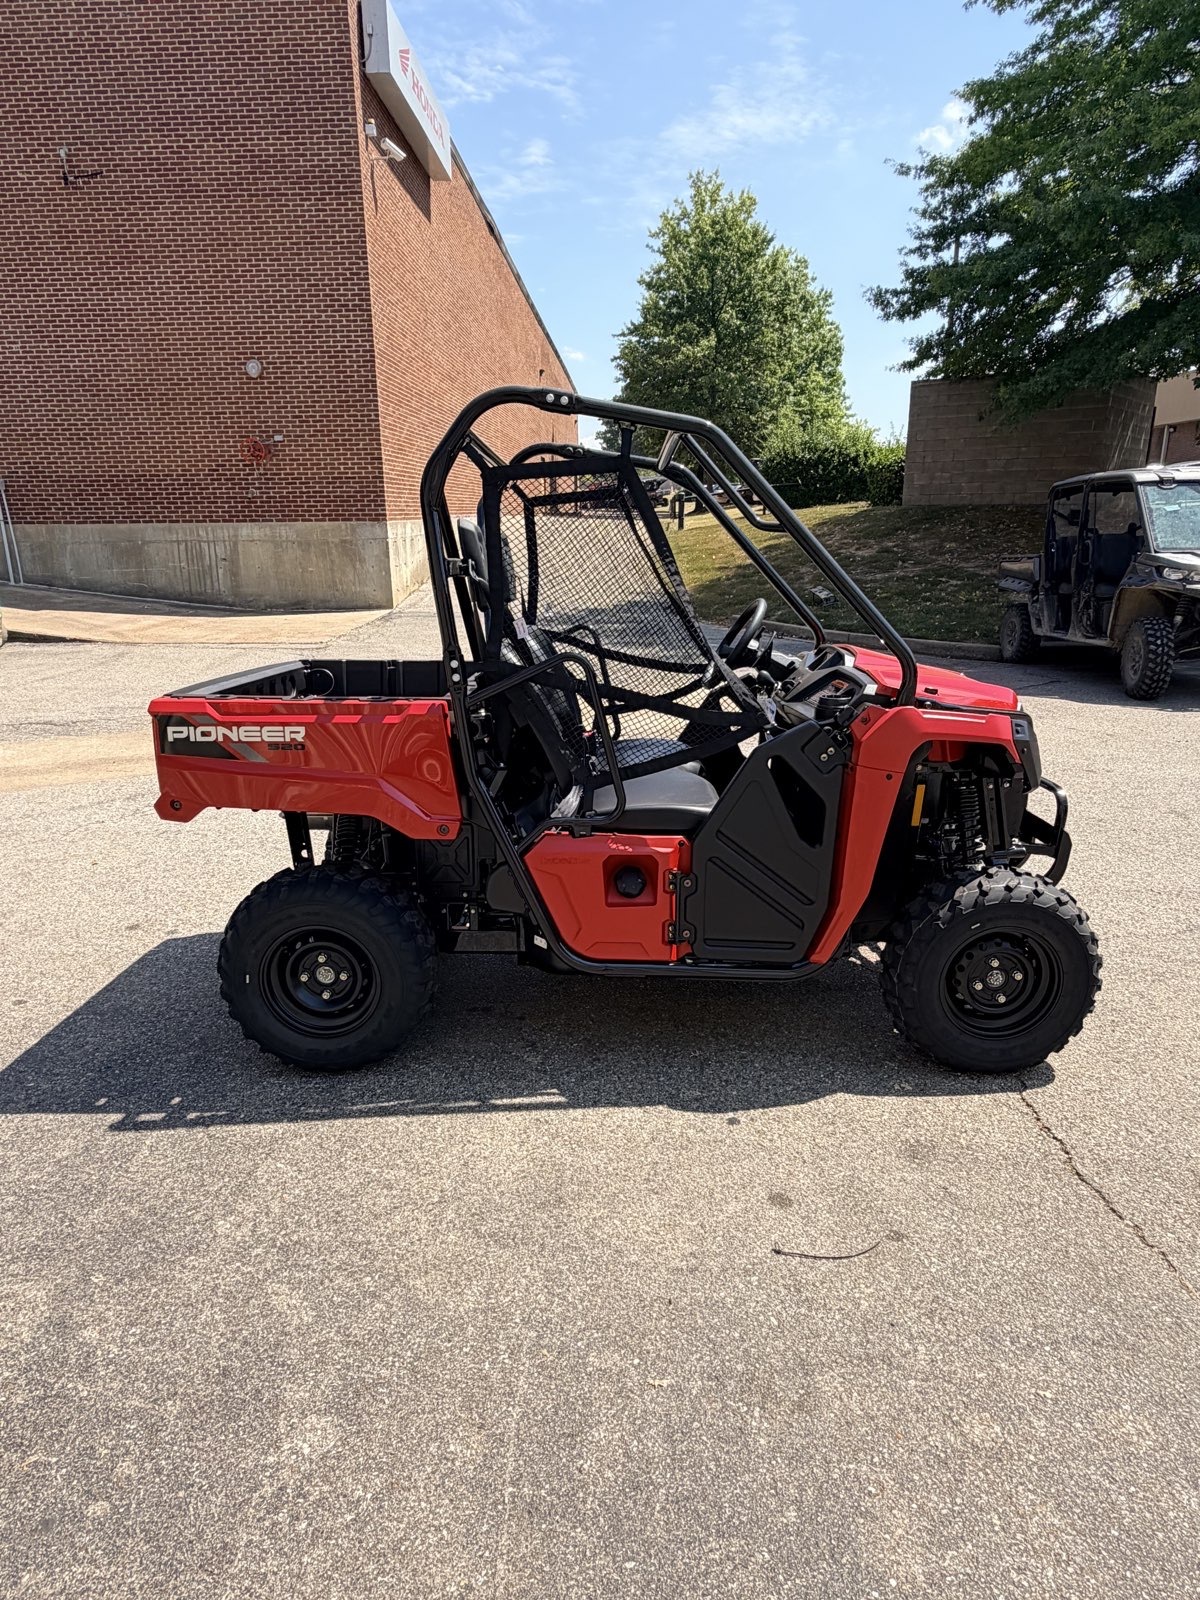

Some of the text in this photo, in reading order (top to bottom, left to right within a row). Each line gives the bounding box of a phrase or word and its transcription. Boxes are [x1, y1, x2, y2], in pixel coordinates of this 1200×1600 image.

[411, 67, 445, 149] HONDA
[166, 726, 306, 743] PIONEER
[267, 743, 306, 751] 520
